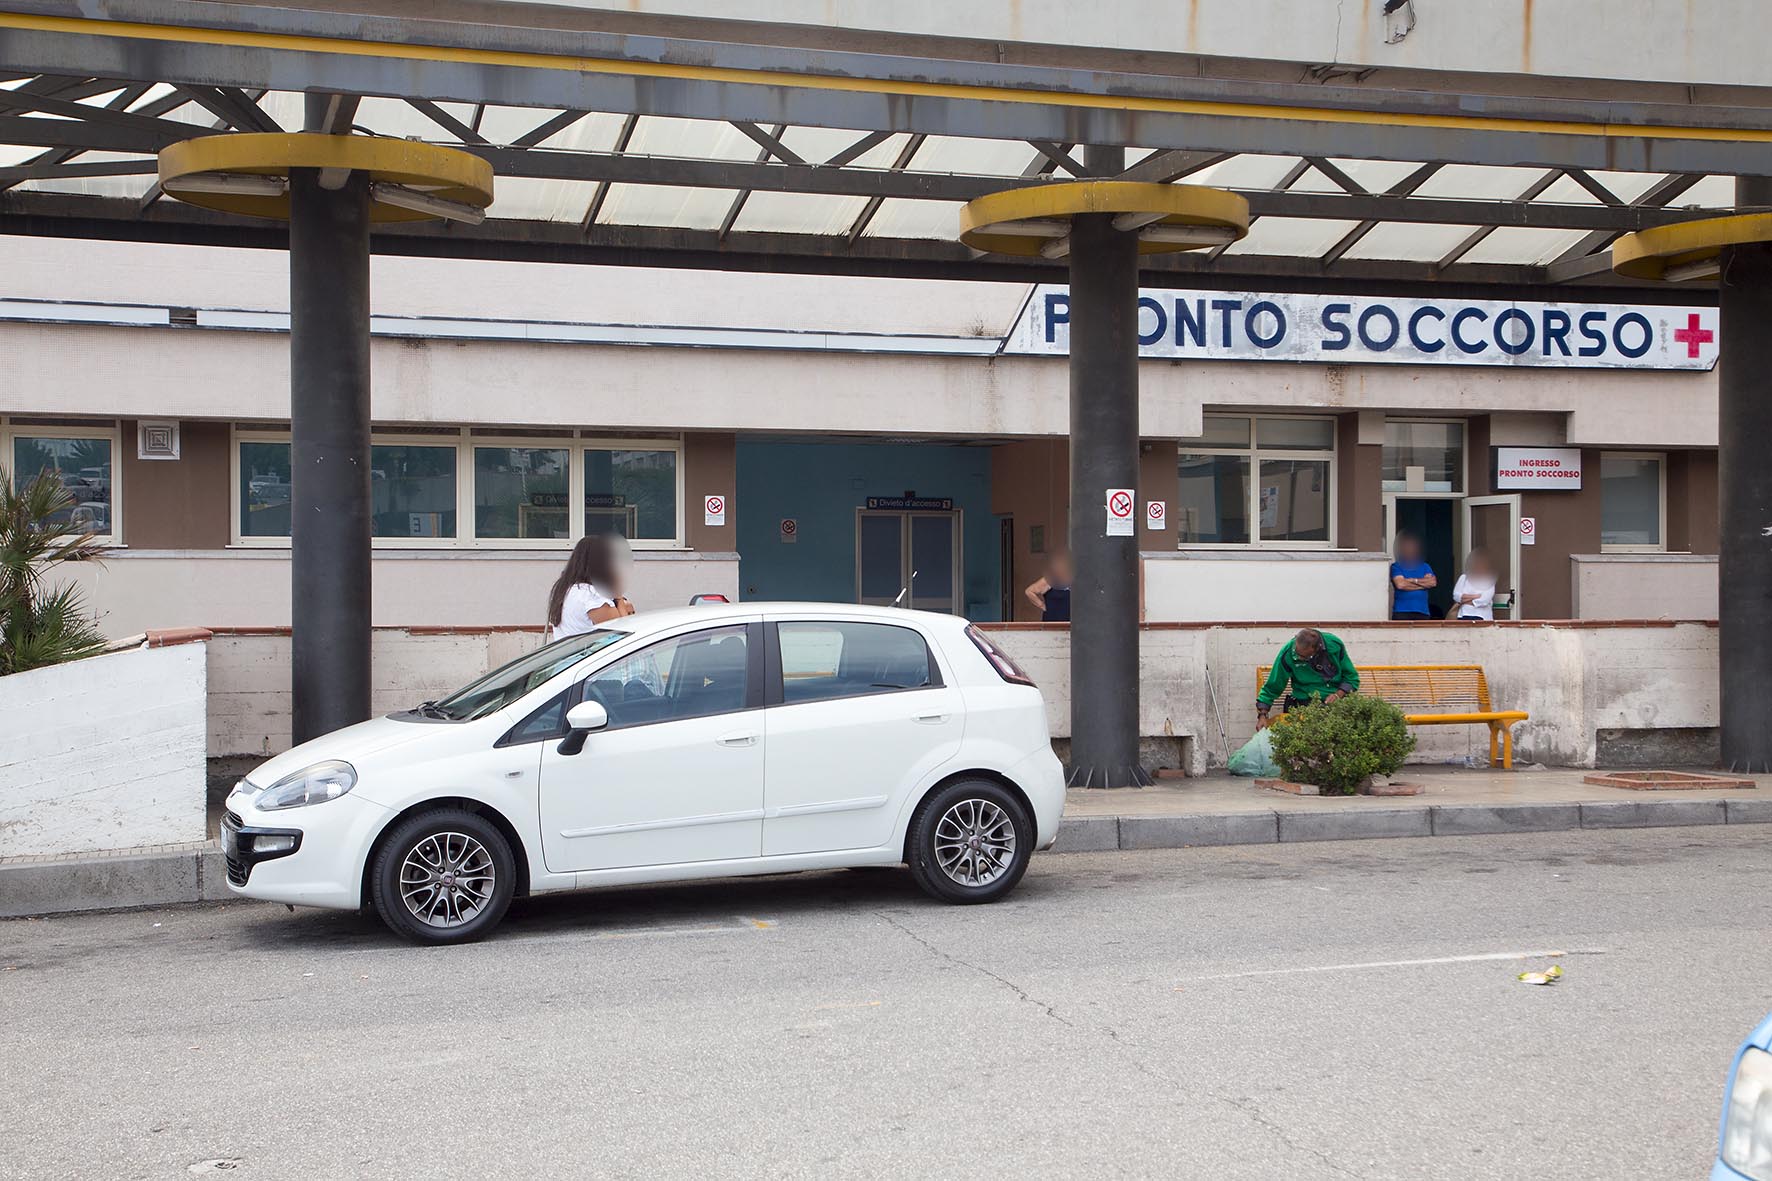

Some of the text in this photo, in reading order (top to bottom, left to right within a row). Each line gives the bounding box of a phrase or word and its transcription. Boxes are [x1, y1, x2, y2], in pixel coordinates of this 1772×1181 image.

[1045, 293, 1654, 359] PONTO SOCCORSO
[1519, 459, 1561, 467] INGRESSO
[1499, 470, 1580, 478] PRONTO SOCCORSO
